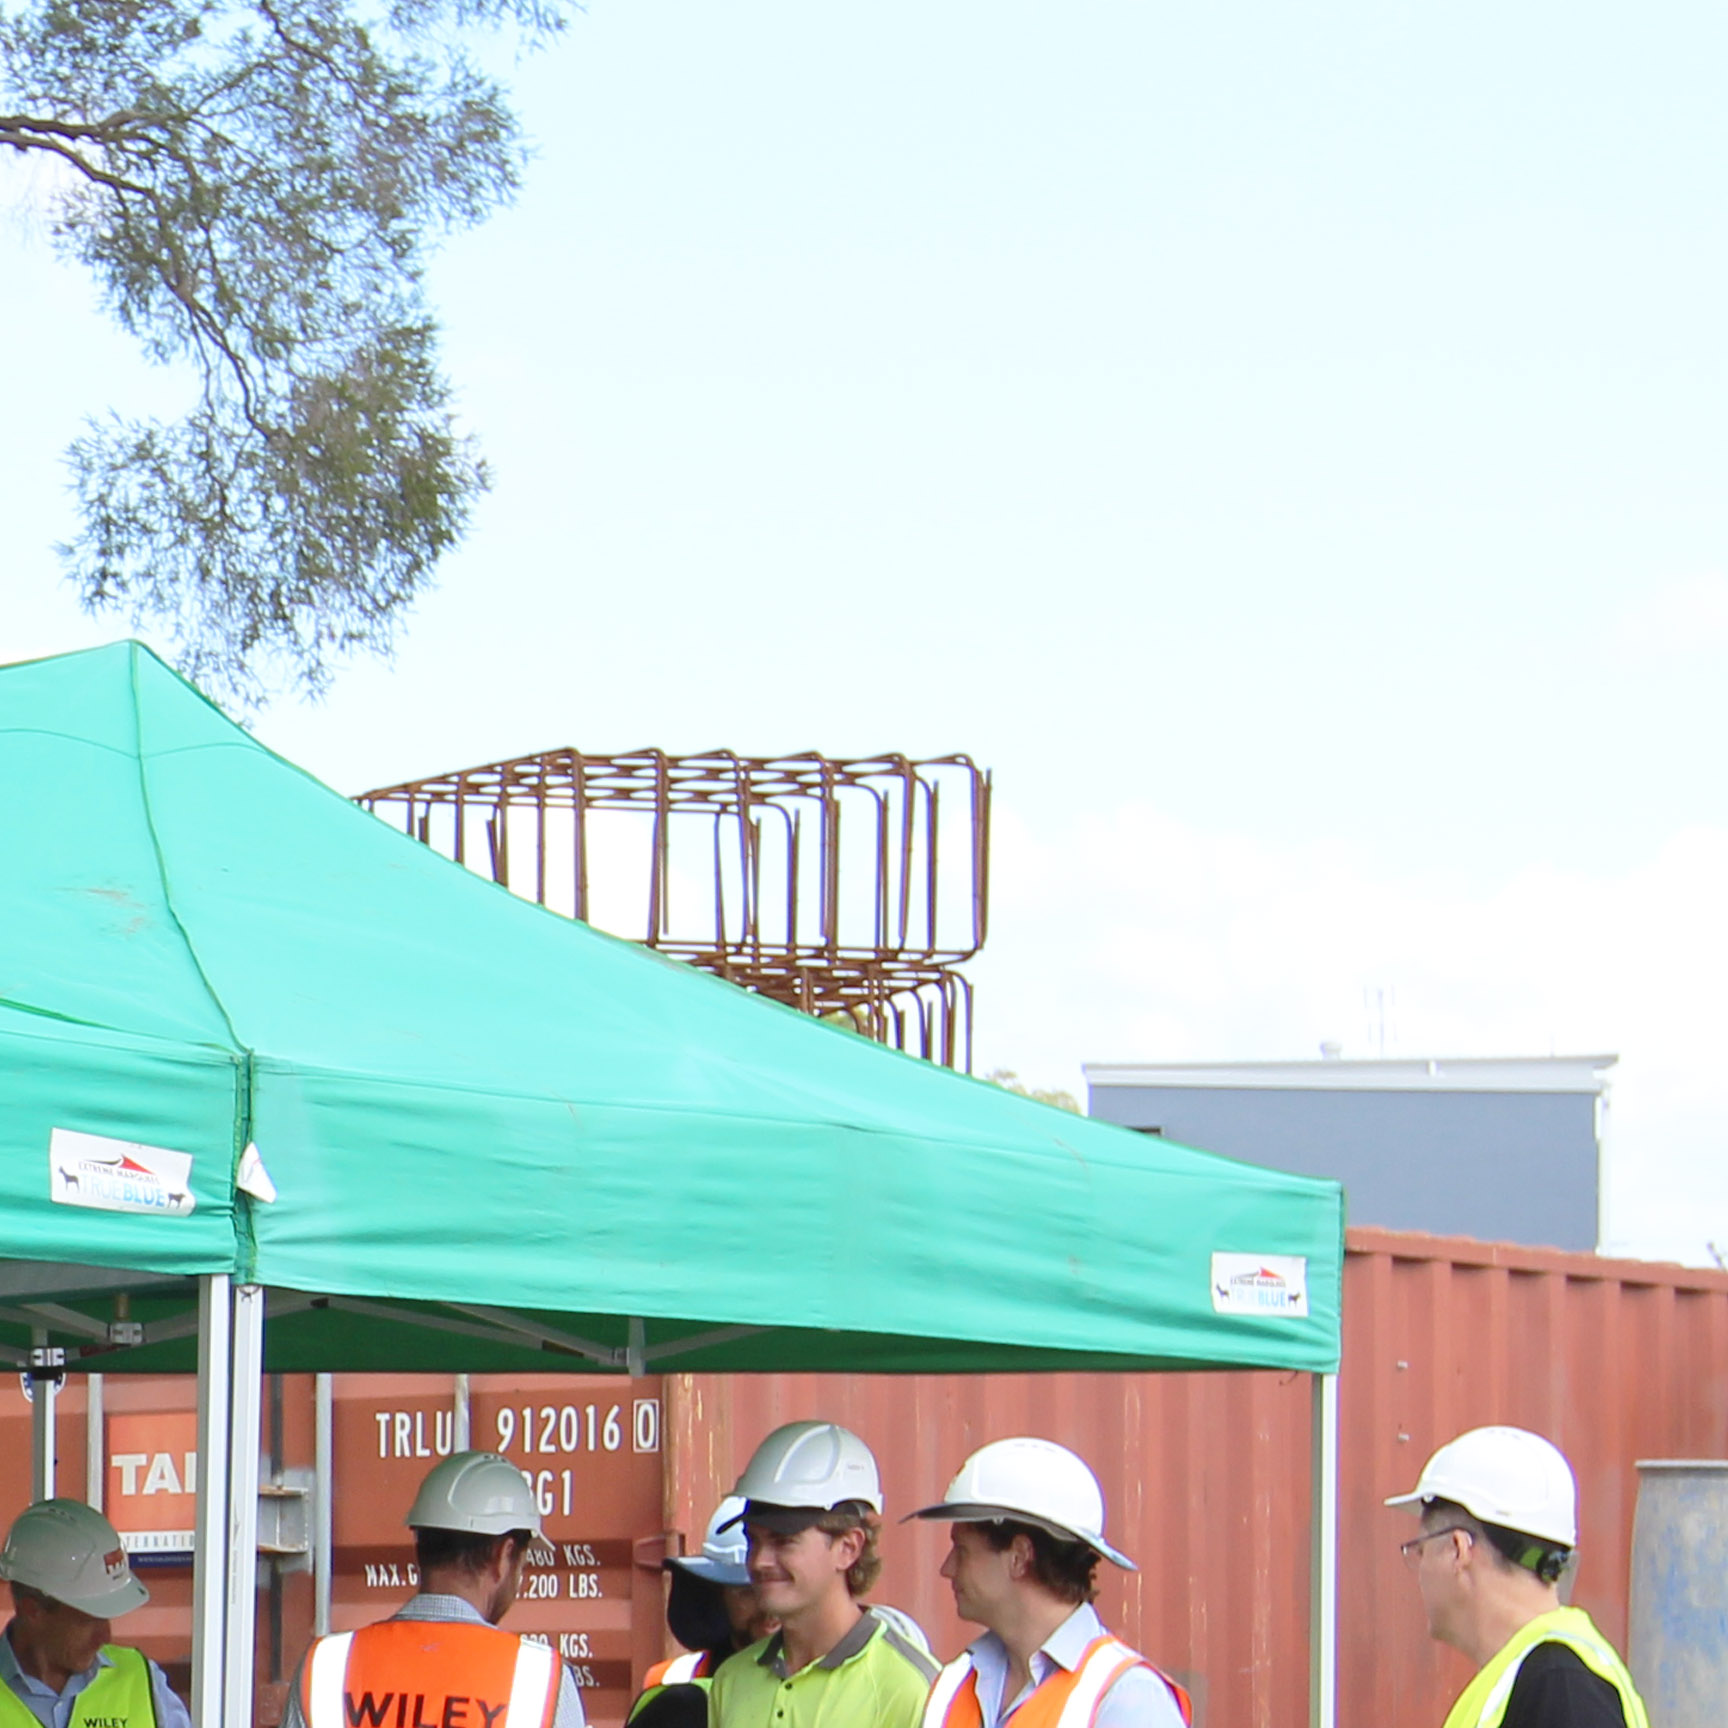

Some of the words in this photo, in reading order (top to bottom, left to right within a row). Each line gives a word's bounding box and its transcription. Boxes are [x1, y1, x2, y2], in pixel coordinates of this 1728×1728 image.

[375, 1411, 452, 1458] TRLU
[497, 1404, 621, 1453] 912016
[564, 1544, 601, 1566] KGS.
[365, 1563, 419, 1588] MAX.G
[515, 1574, 558, 1599] .200
[569, 1573, 603, 1599] LBS.
[560, 1633, 594, 1658] KGS.
[574, 1665, 600, 1687] BS.
[83, 1717, 128, 1728] WILEY
